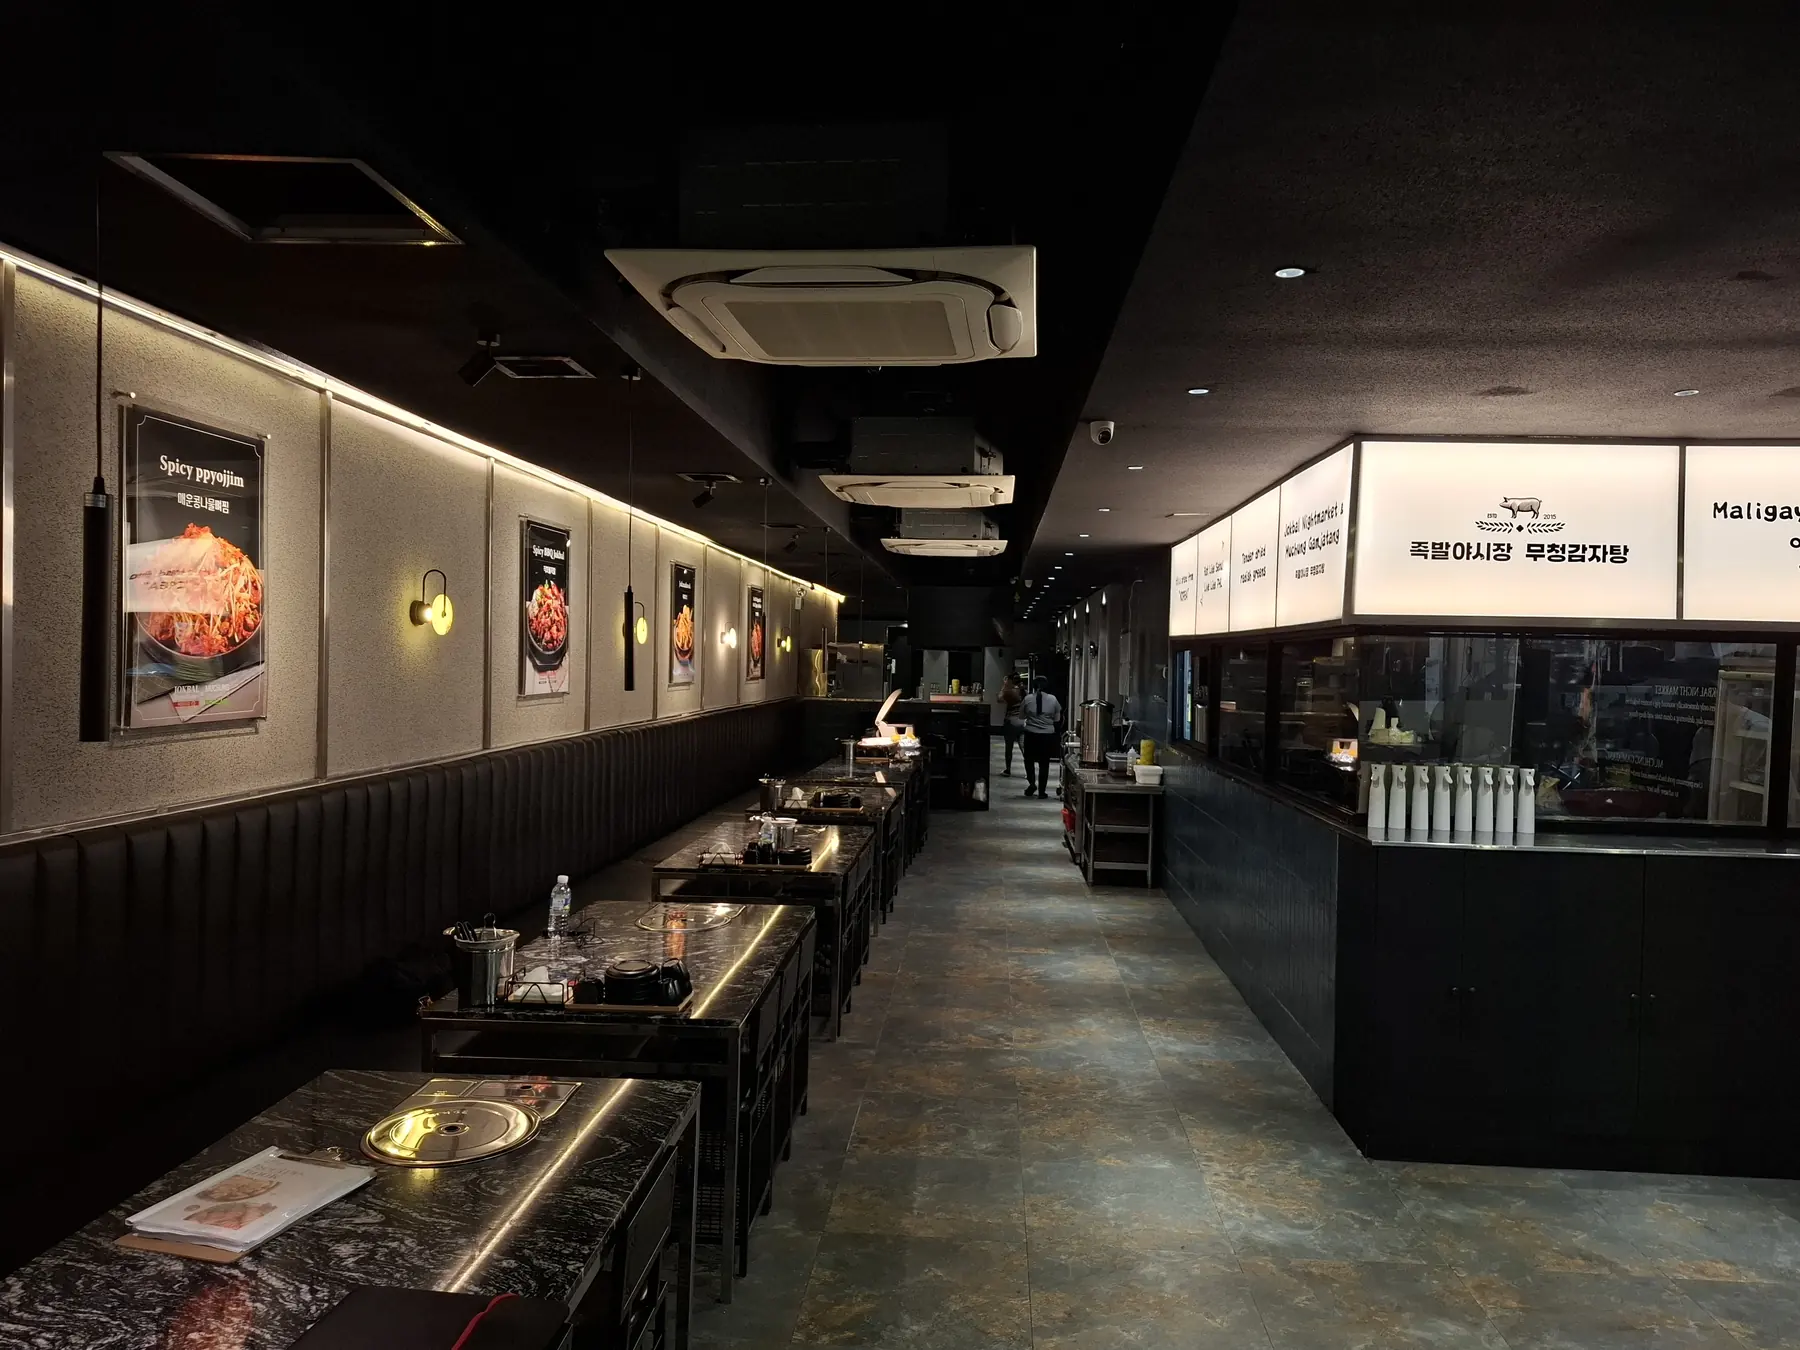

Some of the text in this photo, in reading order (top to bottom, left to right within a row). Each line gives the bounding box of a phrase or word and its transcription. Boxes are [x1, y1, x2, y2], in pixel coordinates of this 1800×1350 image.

[160, 455, 244, 488] Spicy ppyojjim
[532, 544, 544, 558] Spicy
[1409, 541, 1629, 564] 족발야시장 무청감자탕
